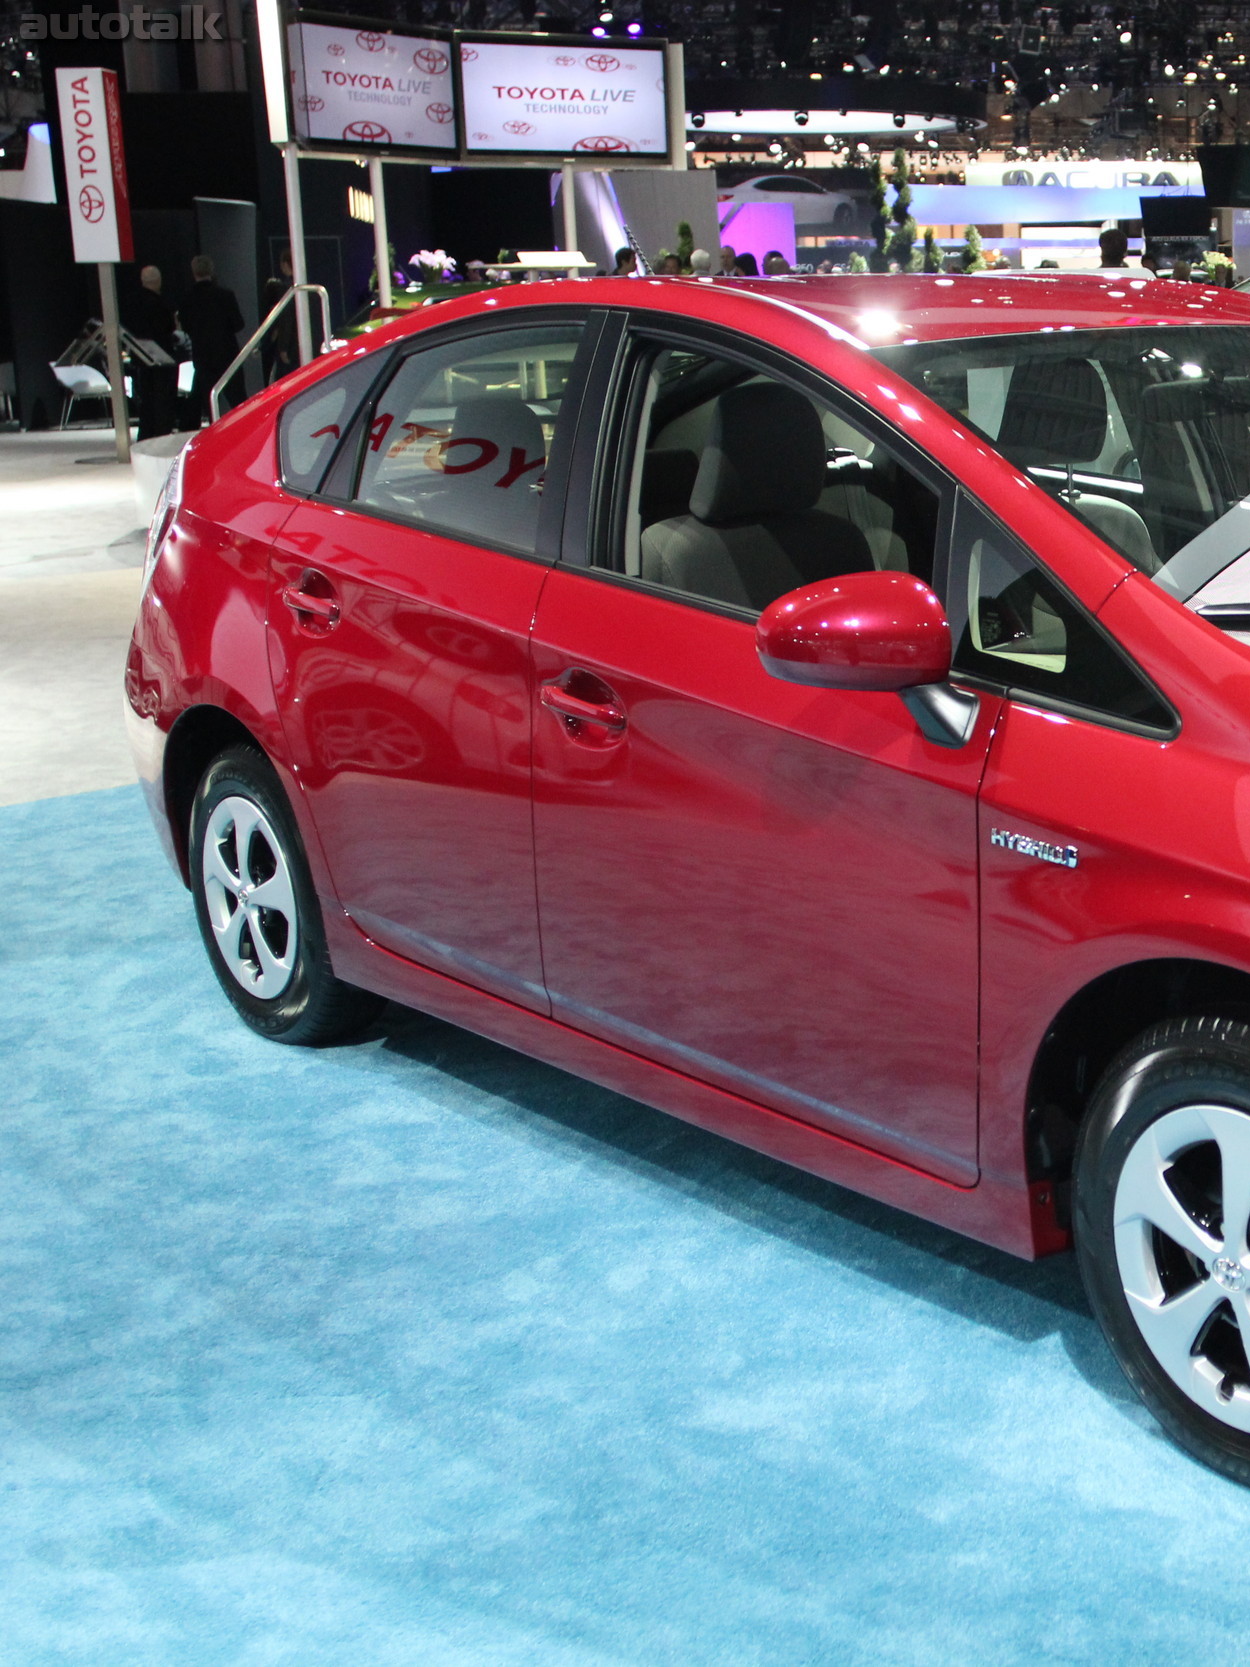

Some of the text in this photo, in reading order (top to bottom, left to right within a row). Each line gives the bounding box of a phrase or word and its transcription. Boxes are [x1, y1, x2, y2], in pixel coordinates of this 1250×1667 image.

[321, 70, 432, 95] TOYOTA LIVE
[347, 90, 413, 106] TECHNOLOGY
[492, 86, 637, 103] TOYOTA LIVE
[524, 103, 609, 115] TECHNOLOGY
[71, 76, 98, 178] TOYOTA
[990, 827, 1066, 865] HYBRID
